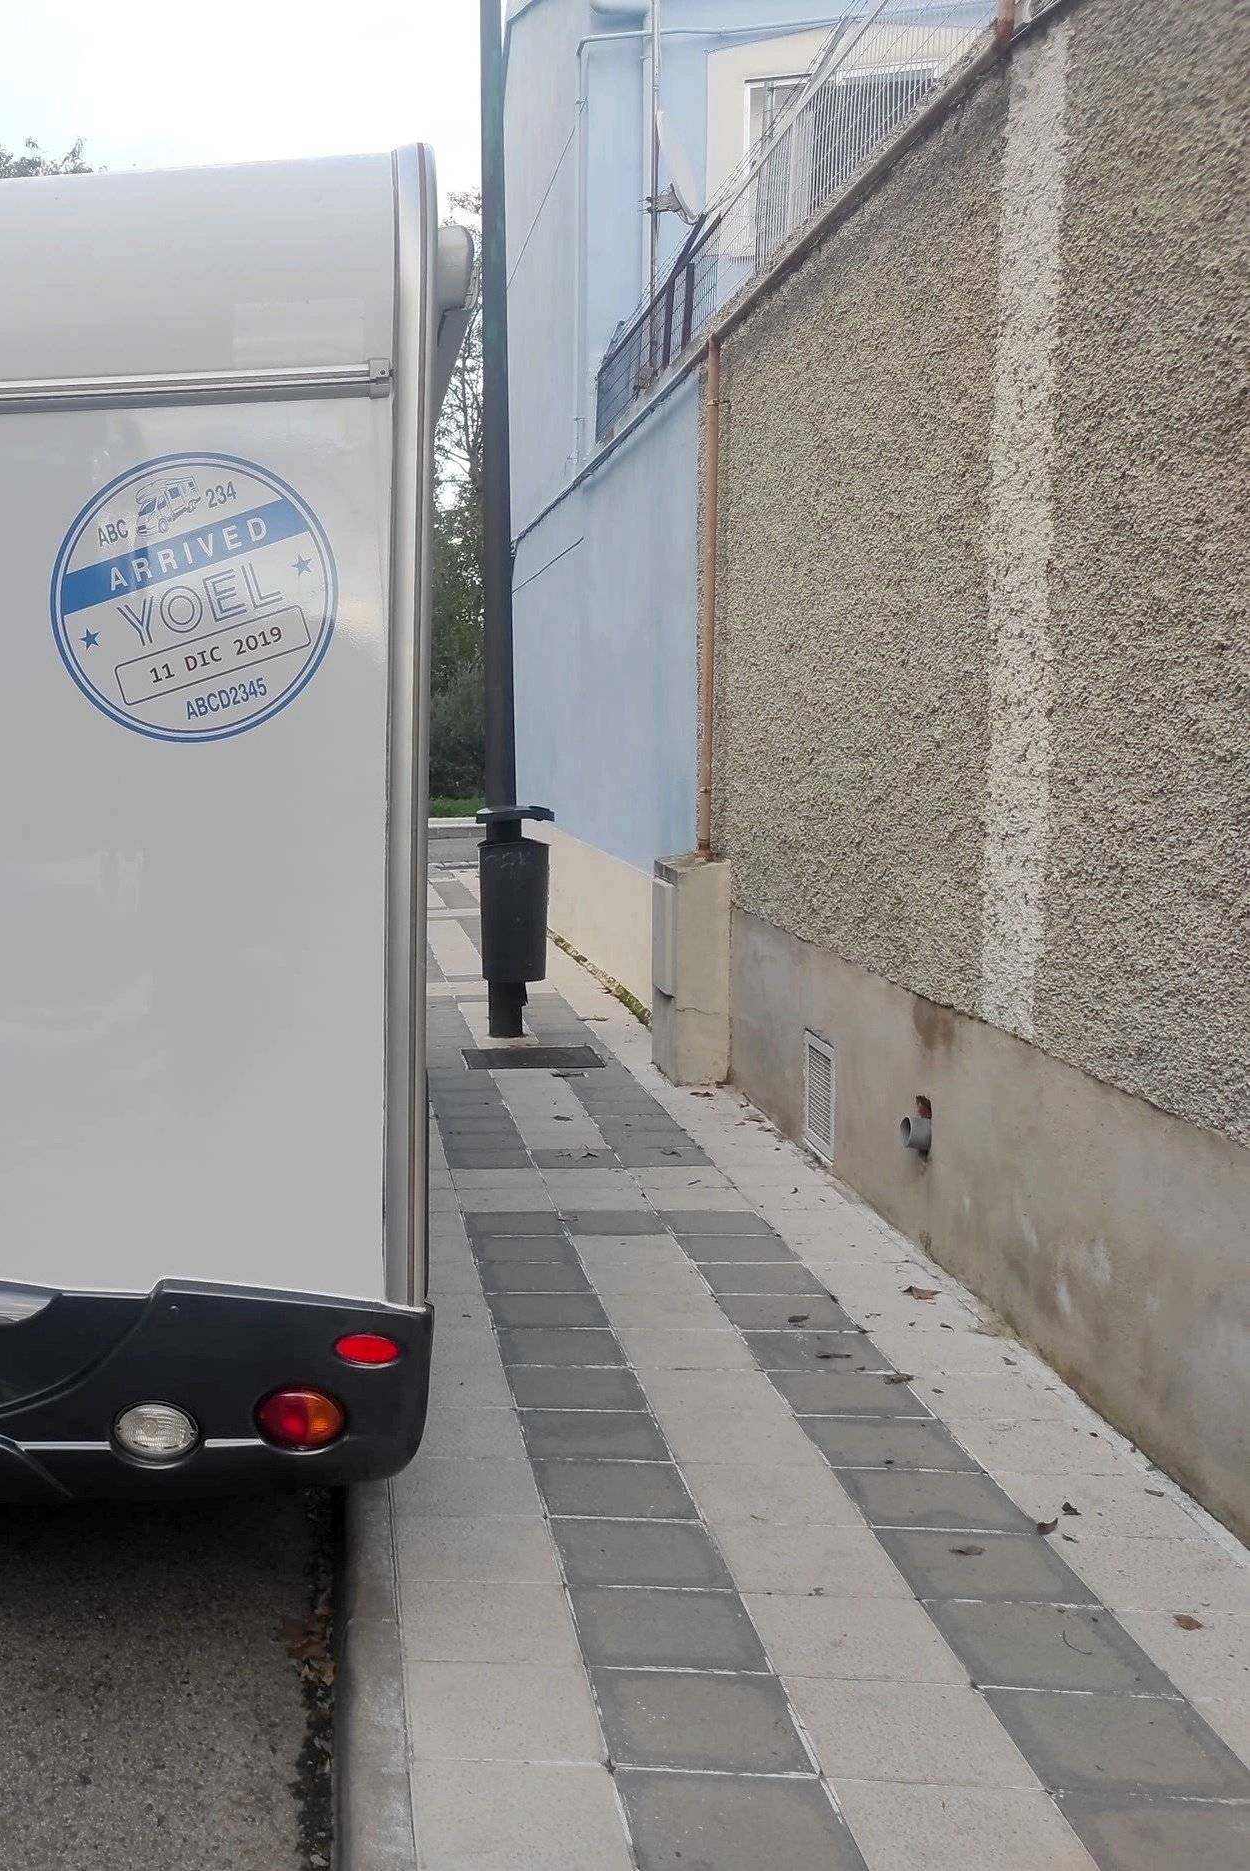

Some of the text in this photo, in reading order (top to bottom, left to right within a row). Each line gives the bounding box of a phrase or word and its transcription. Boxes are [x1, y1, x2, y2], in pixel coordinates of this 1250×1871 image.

[97, 481, 237, 547] ABC 234
[109, 516, 268, 592] ARRIVED
[116, 561, 283, 646] YOEL
[149, 625, 283, 684] 11 DIC 2019
[185, 677, 268, 720] ABCD2345
